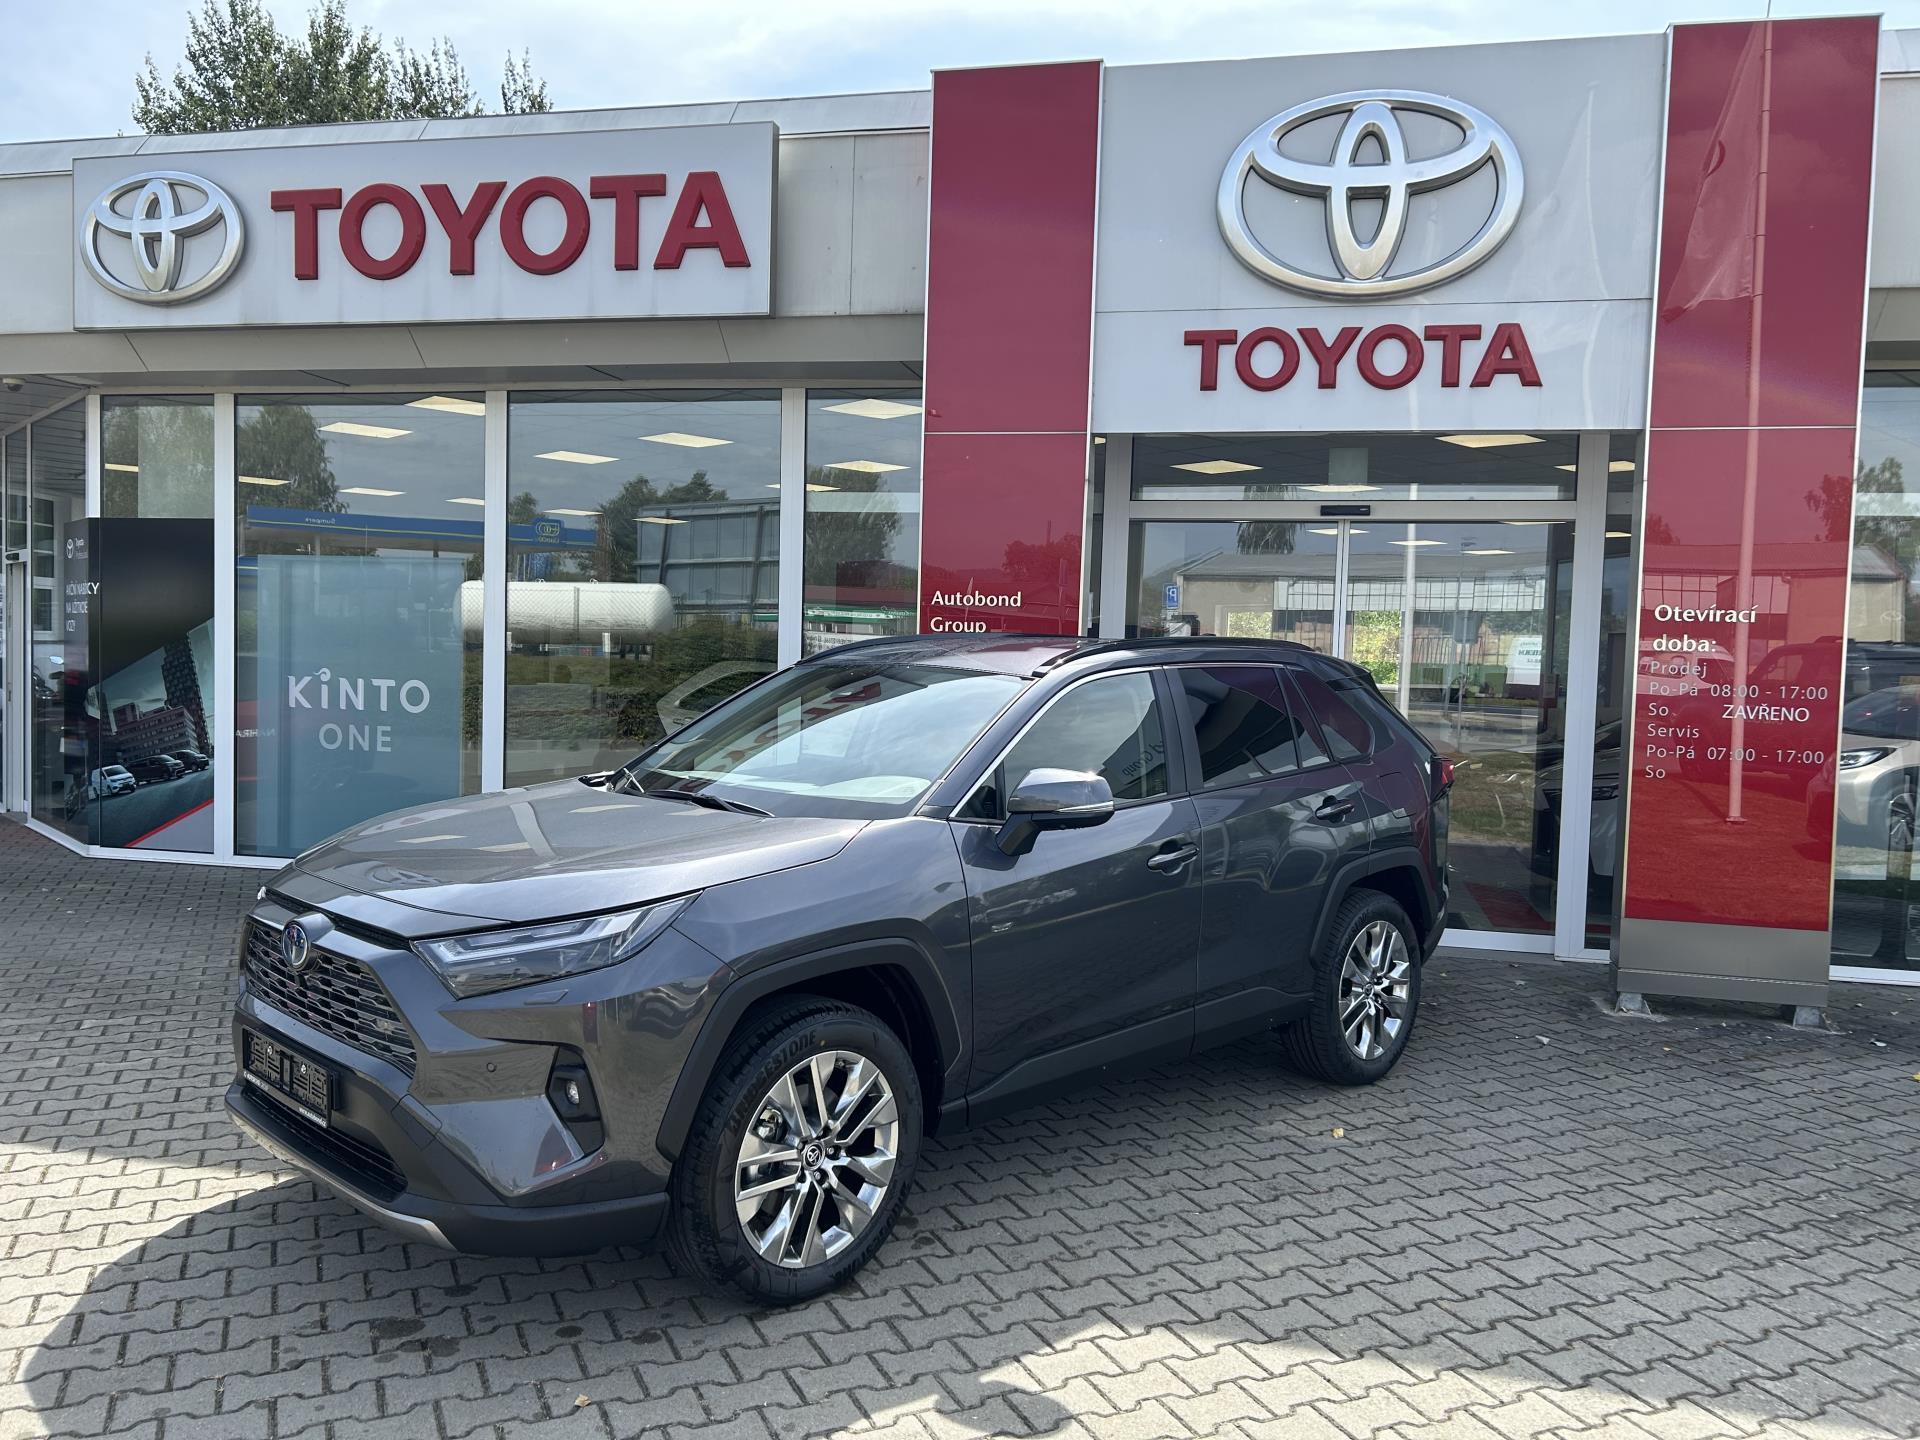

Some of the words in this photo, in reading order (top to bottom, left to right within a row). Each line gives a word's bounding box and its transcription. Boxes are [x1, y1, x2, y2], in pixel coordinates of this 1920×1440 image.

[270, 171, 751, 281] TOYOTA
[1184, 323, 1543, 392] TOYOTA
[931, 590, 1022, 607] Autobond
[1654, 604, 1759, 623] Otevírací
[930, 617, 987, 633] Group
[1652, 633, 1717, 652] doba:
[1650, 660, 1707, 678] Prodej
[1649, 681, 1698, 697] Po-Pá
[1710, 684, 1759, 698] 08:00
[1780, 686, 1828, 700] 17:00
[1648, 703, 1669, 717] So
[1721, 703, 1810, 722] ZAVŘENO
[318, 723, 392, 752] ONE
[1647, 724, 1700, 738] Servis
[1646, 744, 1695, 760] Po-Pá
[1707, 747, 1756, 762] 07:00
[1776, 750, 1824, 764] 17:00
[1645, 765, 1666, 779] So
